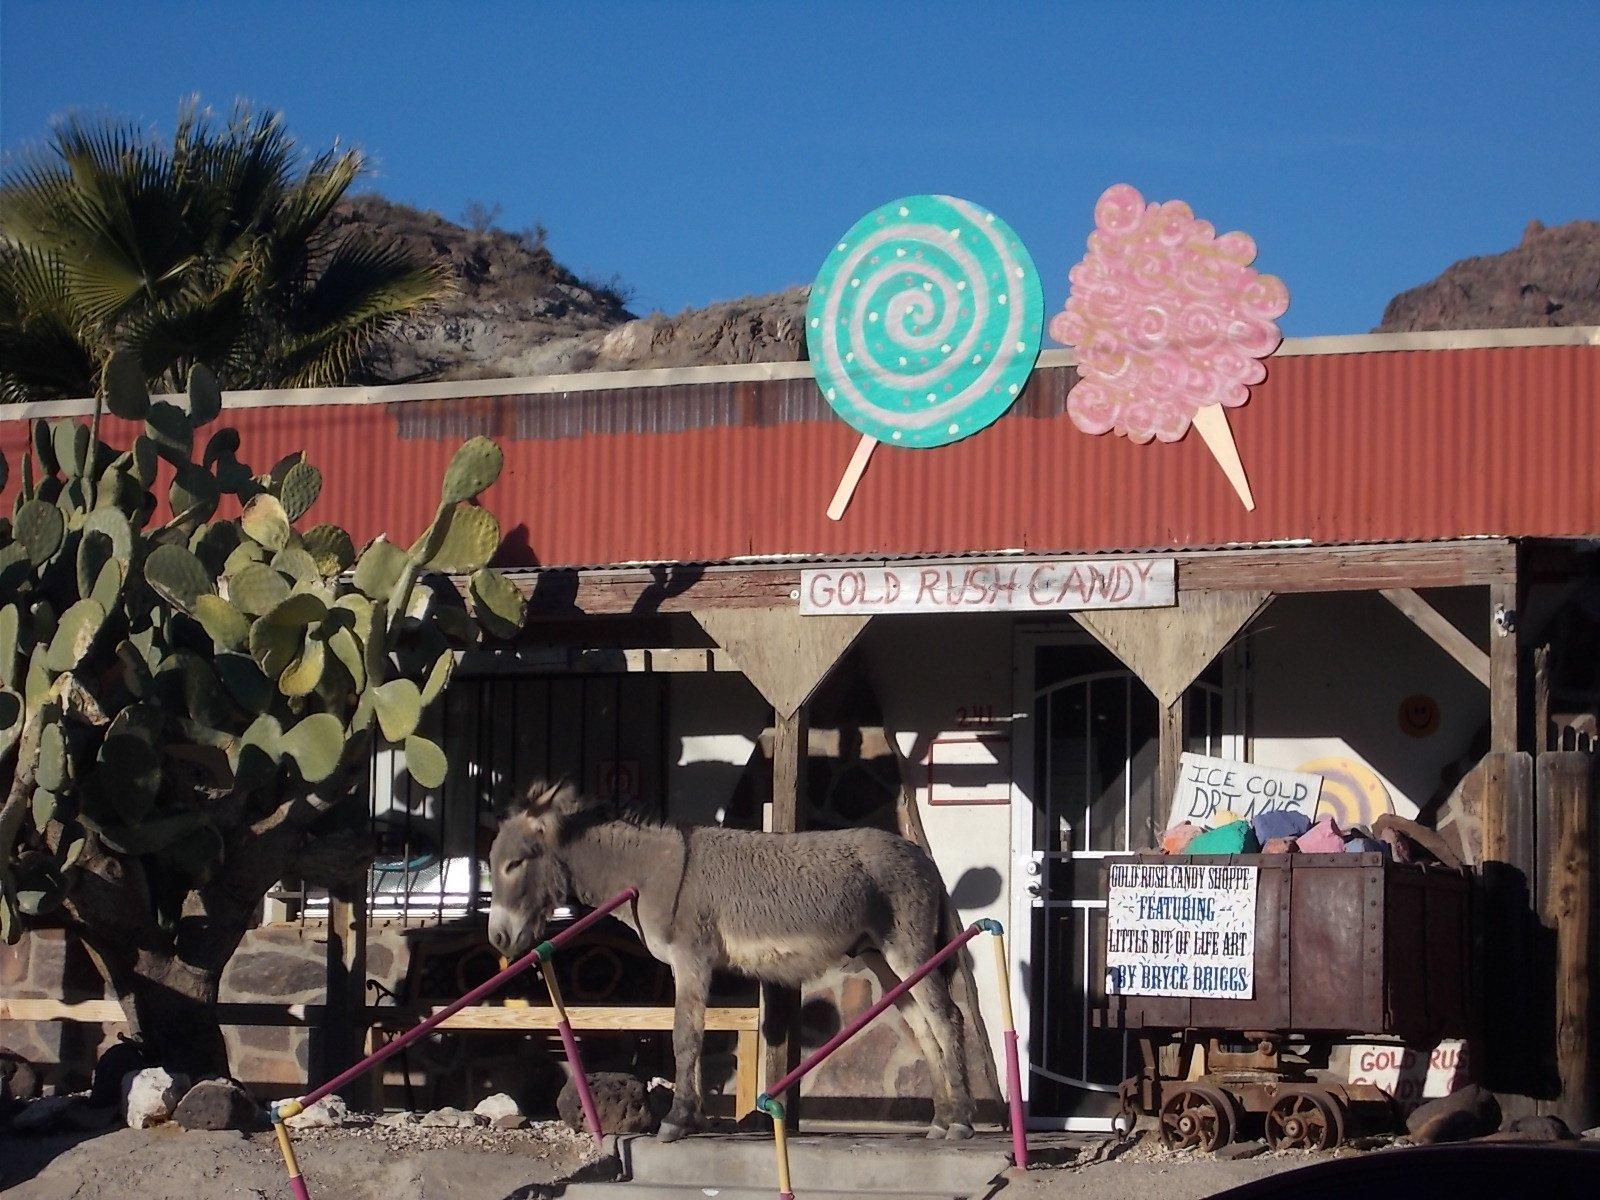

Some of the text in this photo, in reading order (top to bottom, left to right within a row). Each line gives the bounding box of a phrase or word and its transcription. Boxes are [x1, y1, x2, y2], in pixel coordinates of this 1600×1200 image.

[809, 560, 1154, 608] GOLD RUSH CANDY
[1188, 765, 1308, 801] ICE COLD
[1111, 865, 1250, 891] GOLD RUSH CANDY SHOPPE
[1139, 896, 1216, 922] FEATURING
[1109, 929, 1248, 957] LITTLE BIT OF LIFE ART
[1118, 964, 1248, 992] BY BRYCE BRIGGS
[1361, 1050, 1417, 1072] GOLD
